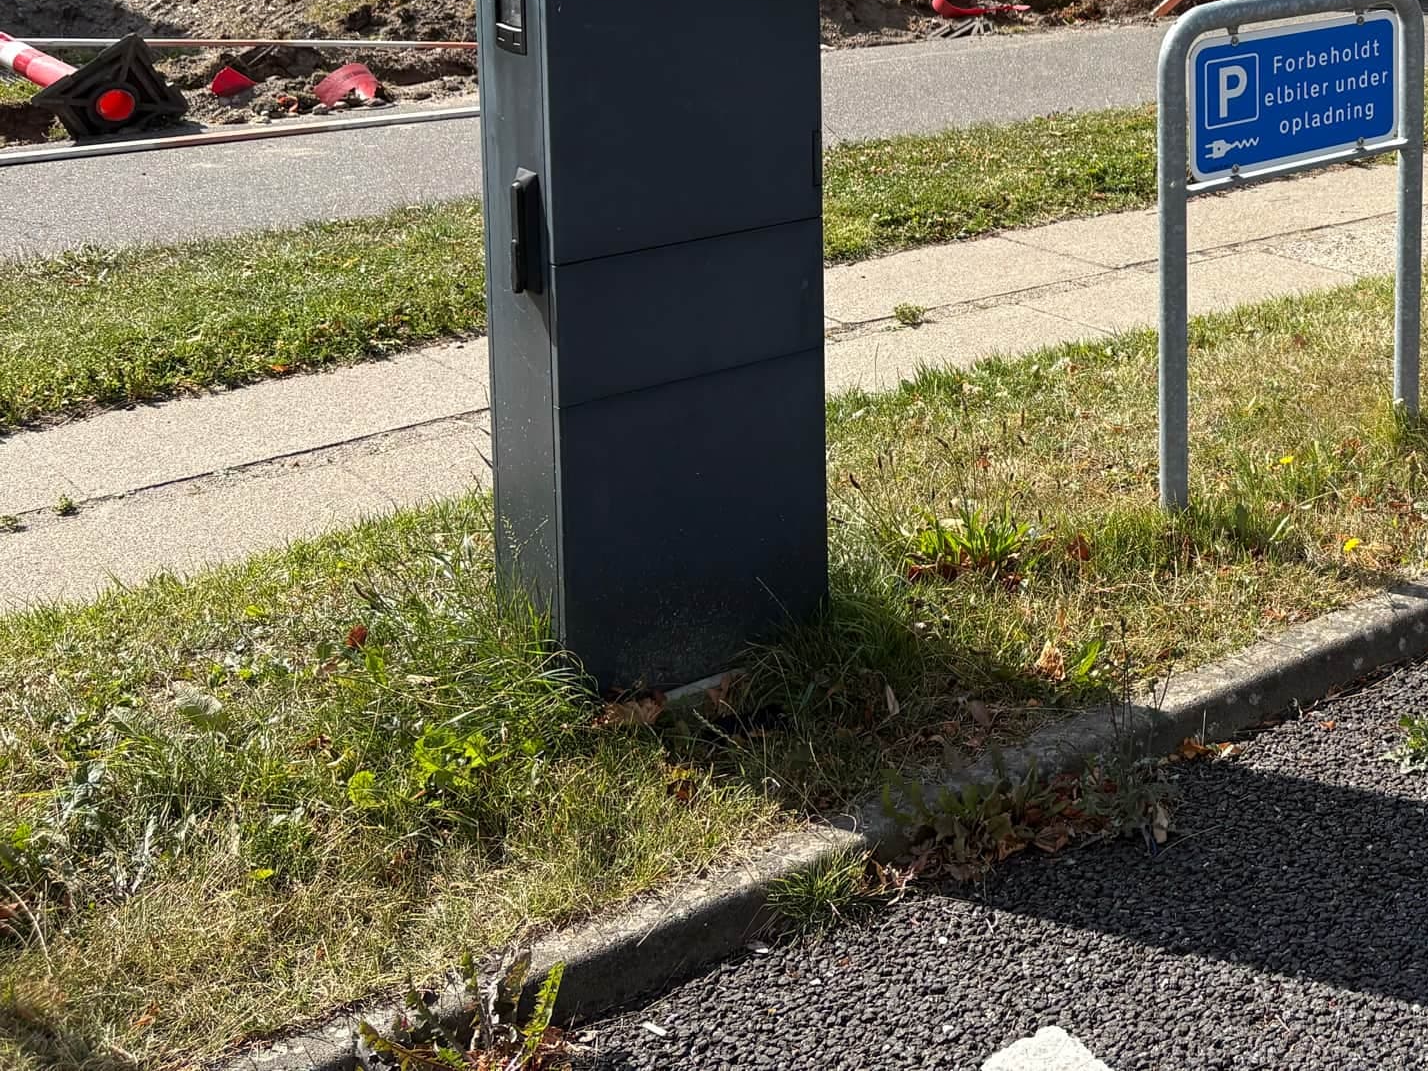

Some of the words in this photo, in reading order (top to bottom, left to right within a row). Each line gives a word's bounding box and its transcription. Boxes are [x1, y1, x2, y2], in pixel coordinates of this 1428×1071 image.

[1273, 39, 1380, 74] Forbeholdt
[1219, 65, 1248, 119] P
[1264, 82, 1328, 106] elbiler
[1336, 69, 1389, 92] under
[1280, 101, 1375, 135] opladning
